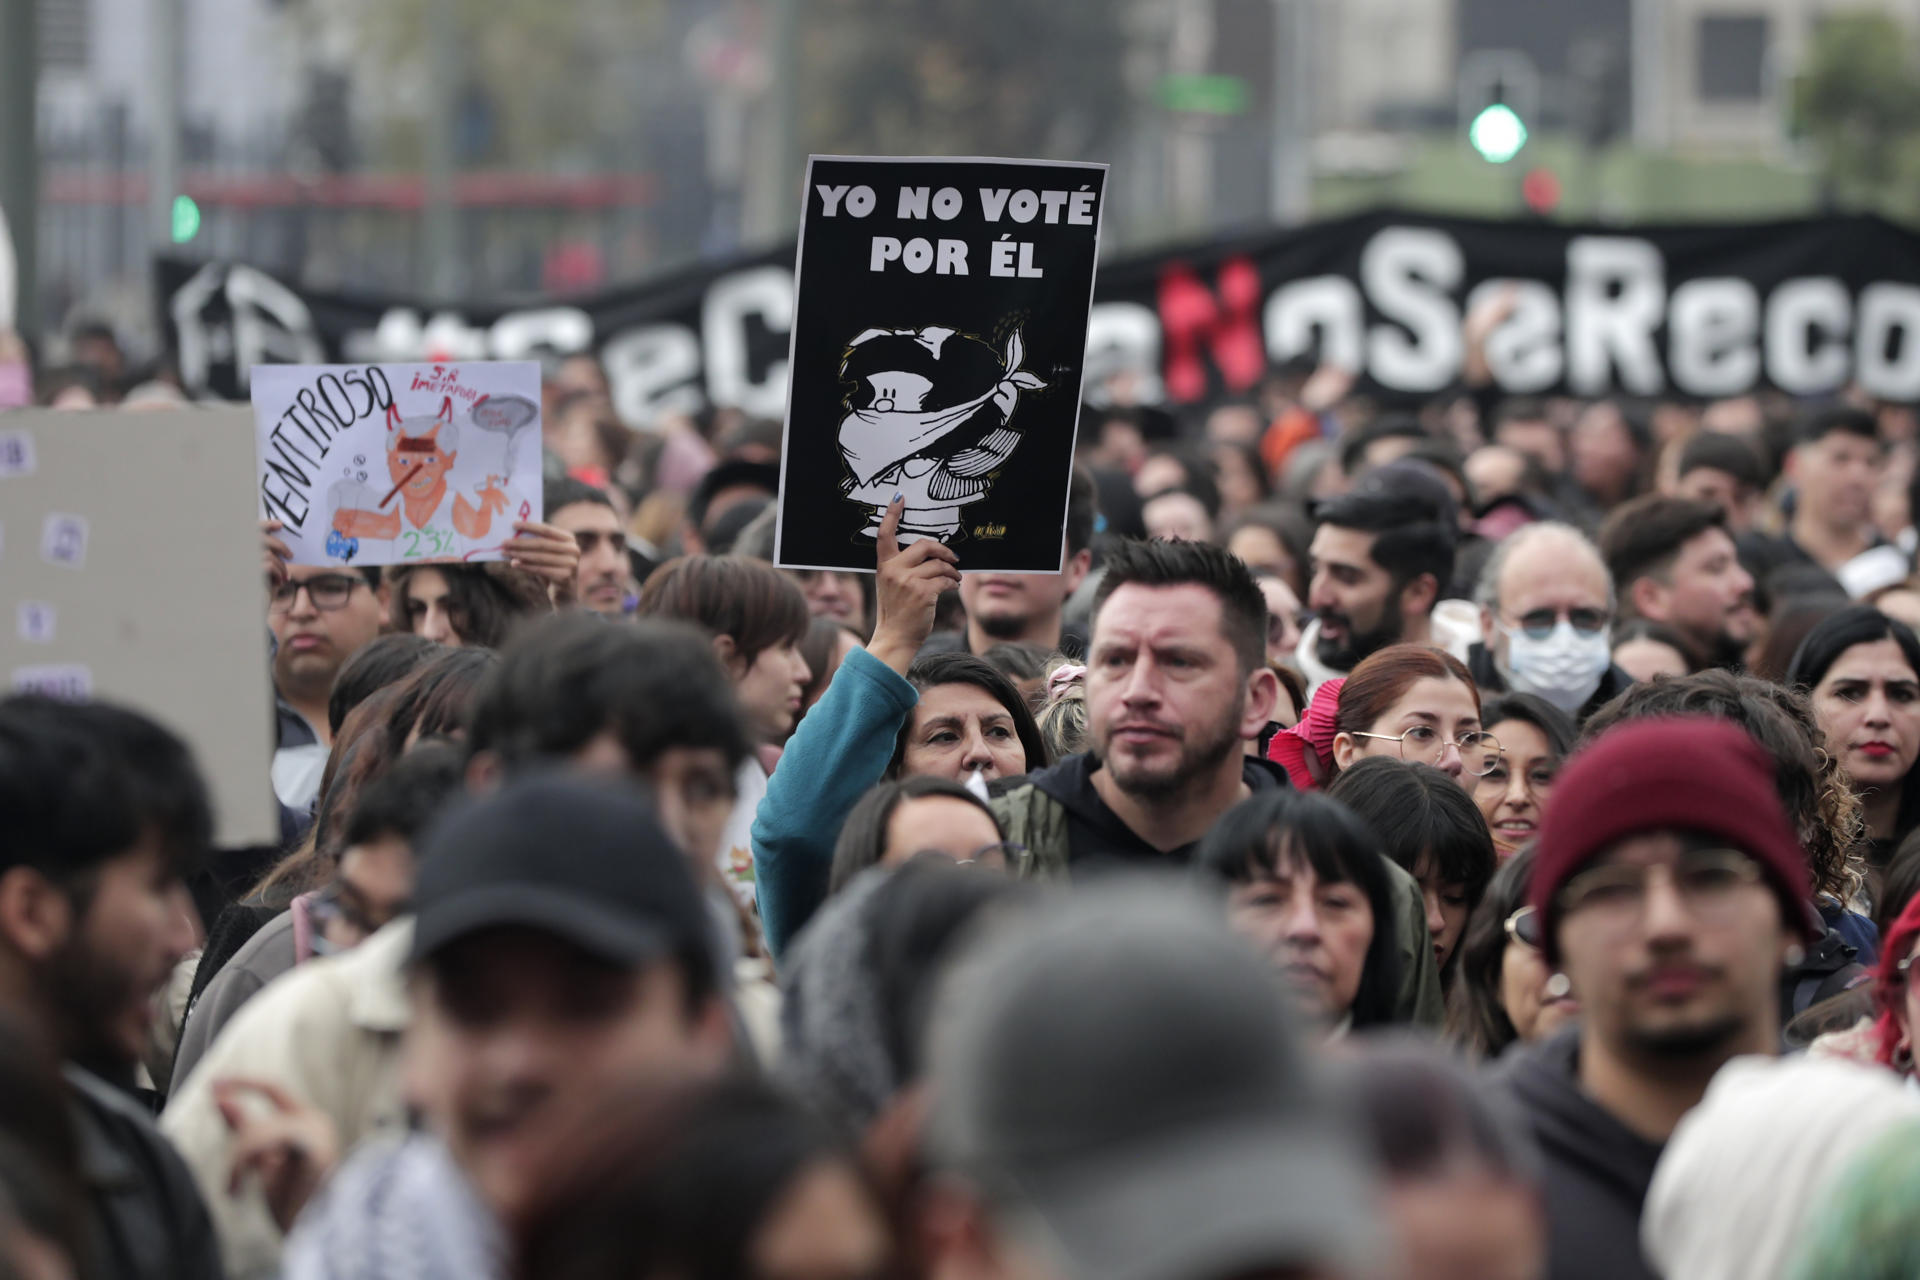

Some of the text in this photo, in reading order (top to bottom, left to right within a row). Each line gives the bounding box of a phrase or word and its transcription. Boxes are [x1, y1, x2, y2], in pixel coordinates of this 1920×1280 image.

[815, 184, 1096, 226] YO NO VOTÉ
[869, 234, 1044, 278] POR ÉL
[402, 528, 455, 558] 23%
